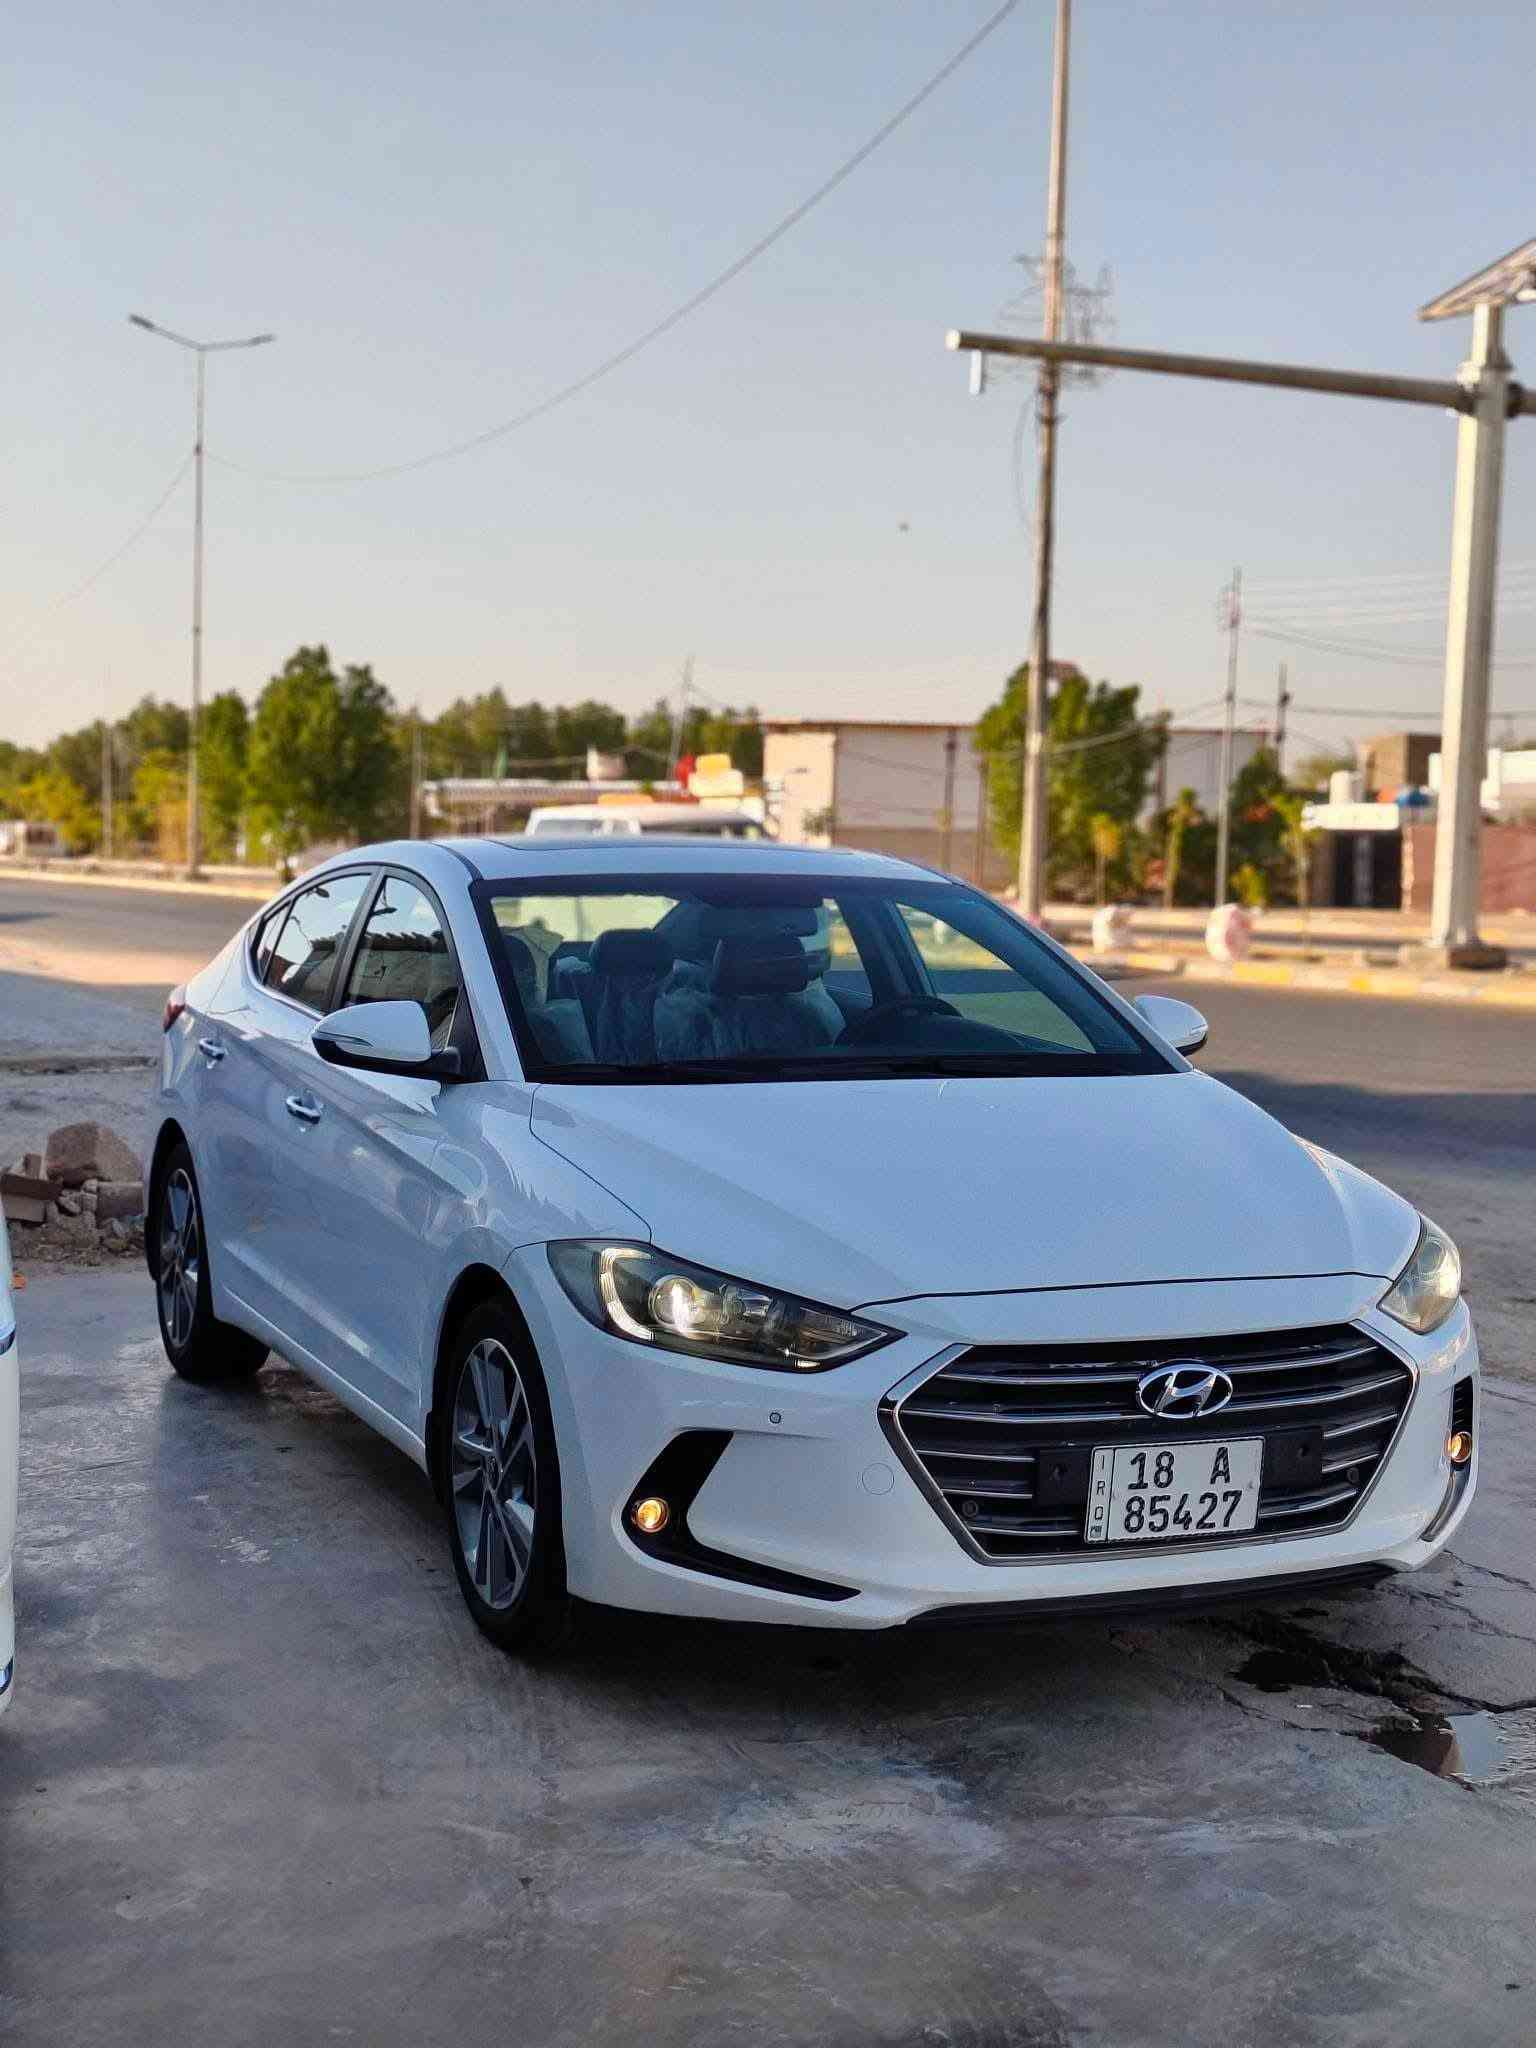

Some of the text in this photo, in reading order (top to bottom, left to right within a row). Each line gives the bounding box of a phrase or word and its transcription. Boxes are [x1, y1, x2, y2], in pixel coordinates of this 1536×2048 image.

[1128, 1446, 1231, 1489] 18 A
[1124, 1490, 1242, 1532] 85427
